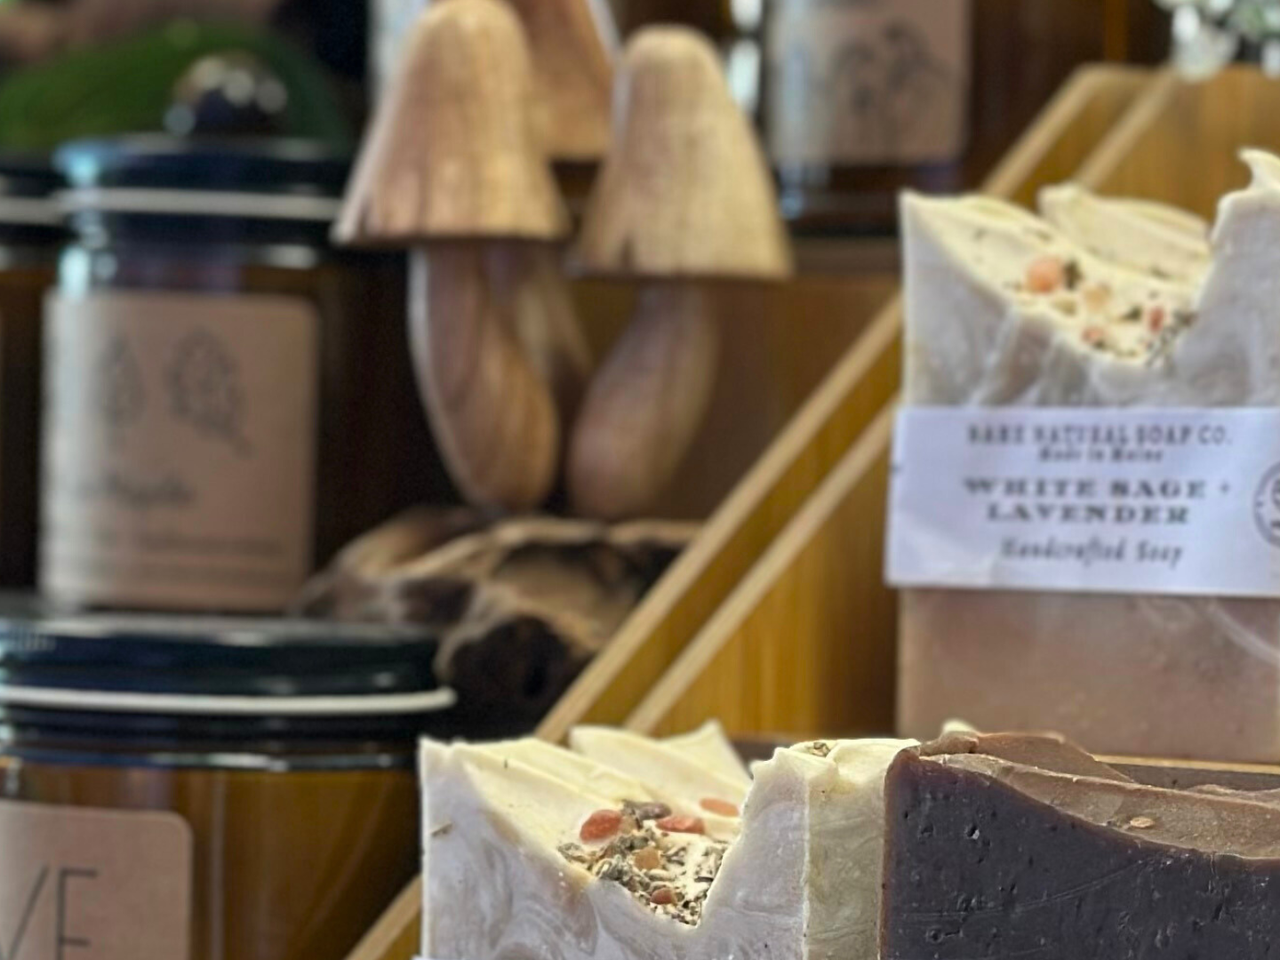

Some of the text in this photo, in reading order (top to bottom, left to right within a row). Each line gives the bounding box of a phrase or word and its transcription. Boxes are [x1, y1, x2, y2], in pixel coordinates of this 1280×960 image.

[1033, 424, 1129, 445] NATURAL
[1136, 425, 1192, 445] SOAP
[1197, 426, 1232, 445] CO.
[963, 477, 1098, 498] WHITE
[1108, 478, 1208, 500] SAGE
[985, 503, 1191, 524] LAVENDER
[1000, 536, 1184, 568] Handcrafted Soap
